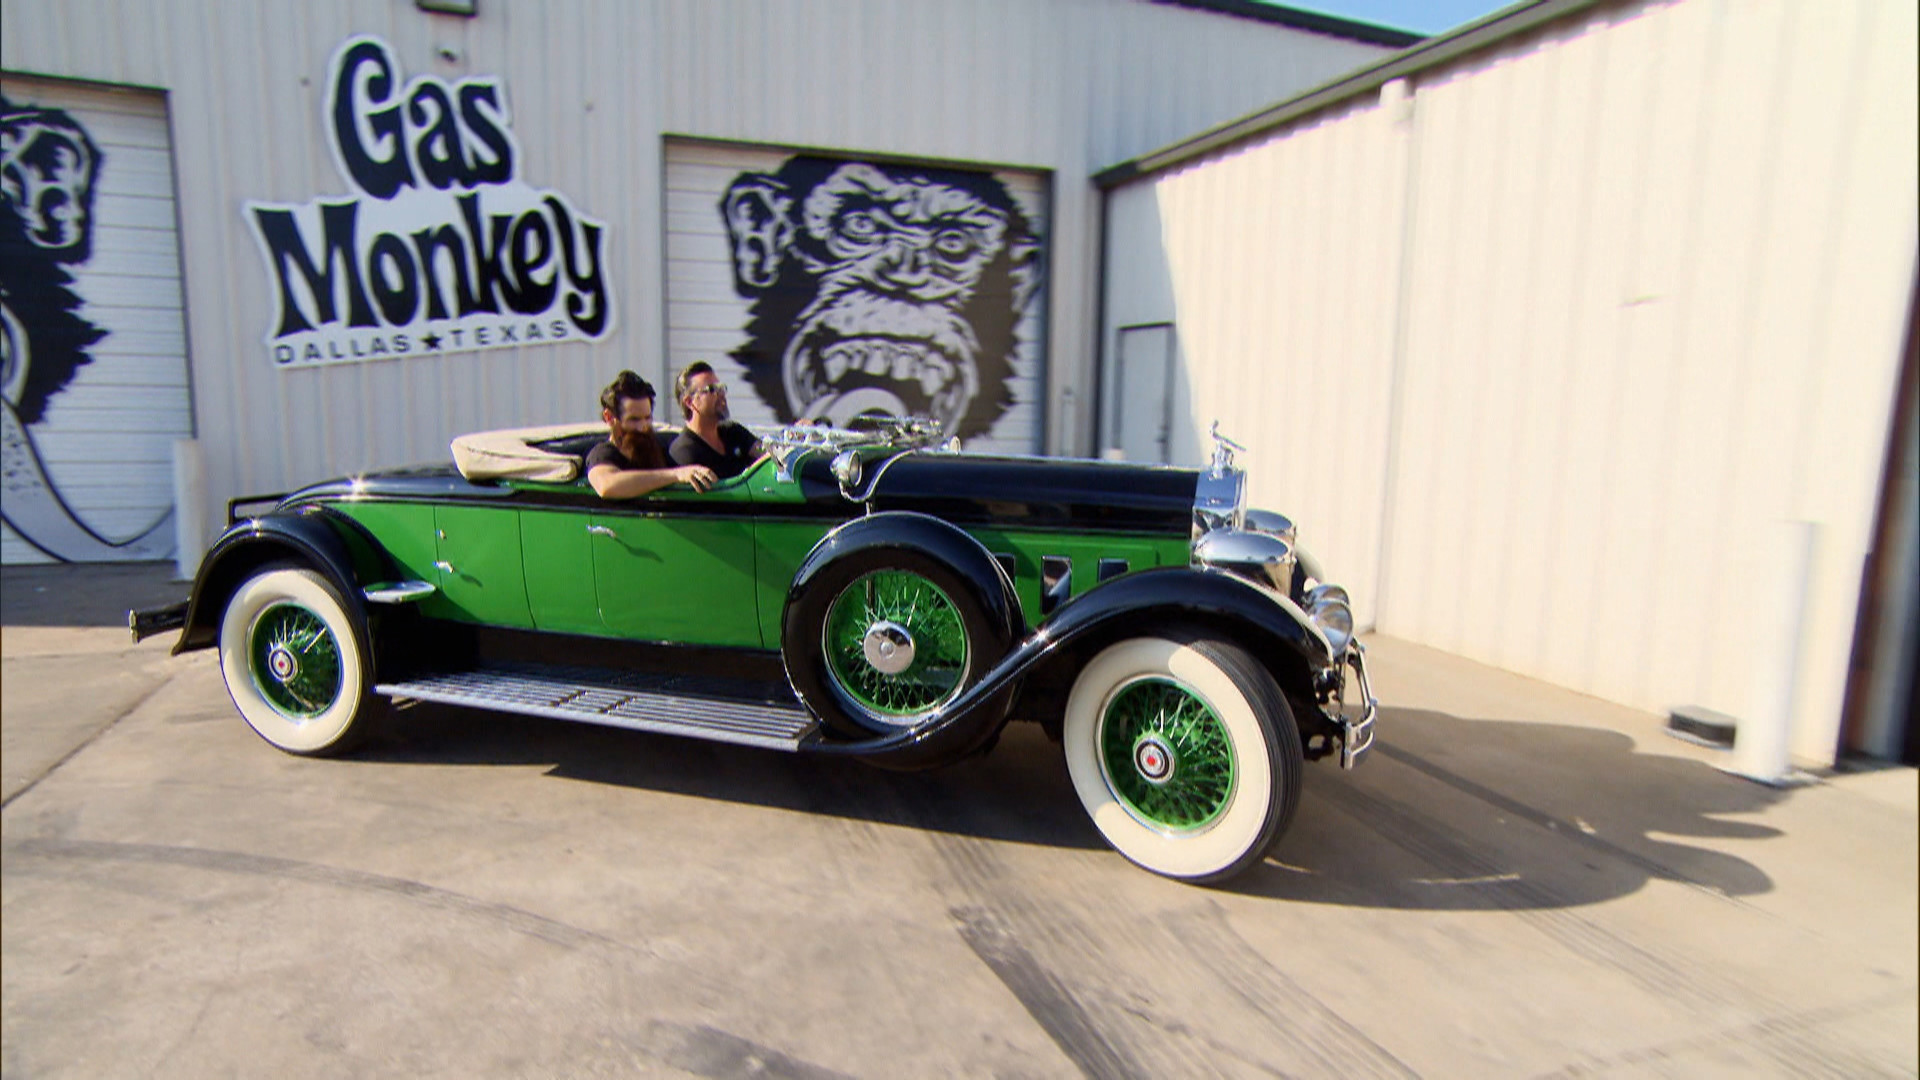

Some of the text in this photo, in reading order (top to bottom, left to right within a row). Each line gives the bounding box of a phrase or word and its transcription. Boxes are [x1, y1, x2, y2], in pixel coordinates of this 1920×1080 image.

[333, 41, 513, 200] Gas
[252, 192, 608, 338] Monkey
[275, 320, 569, 364] DALLAS TEXAS
